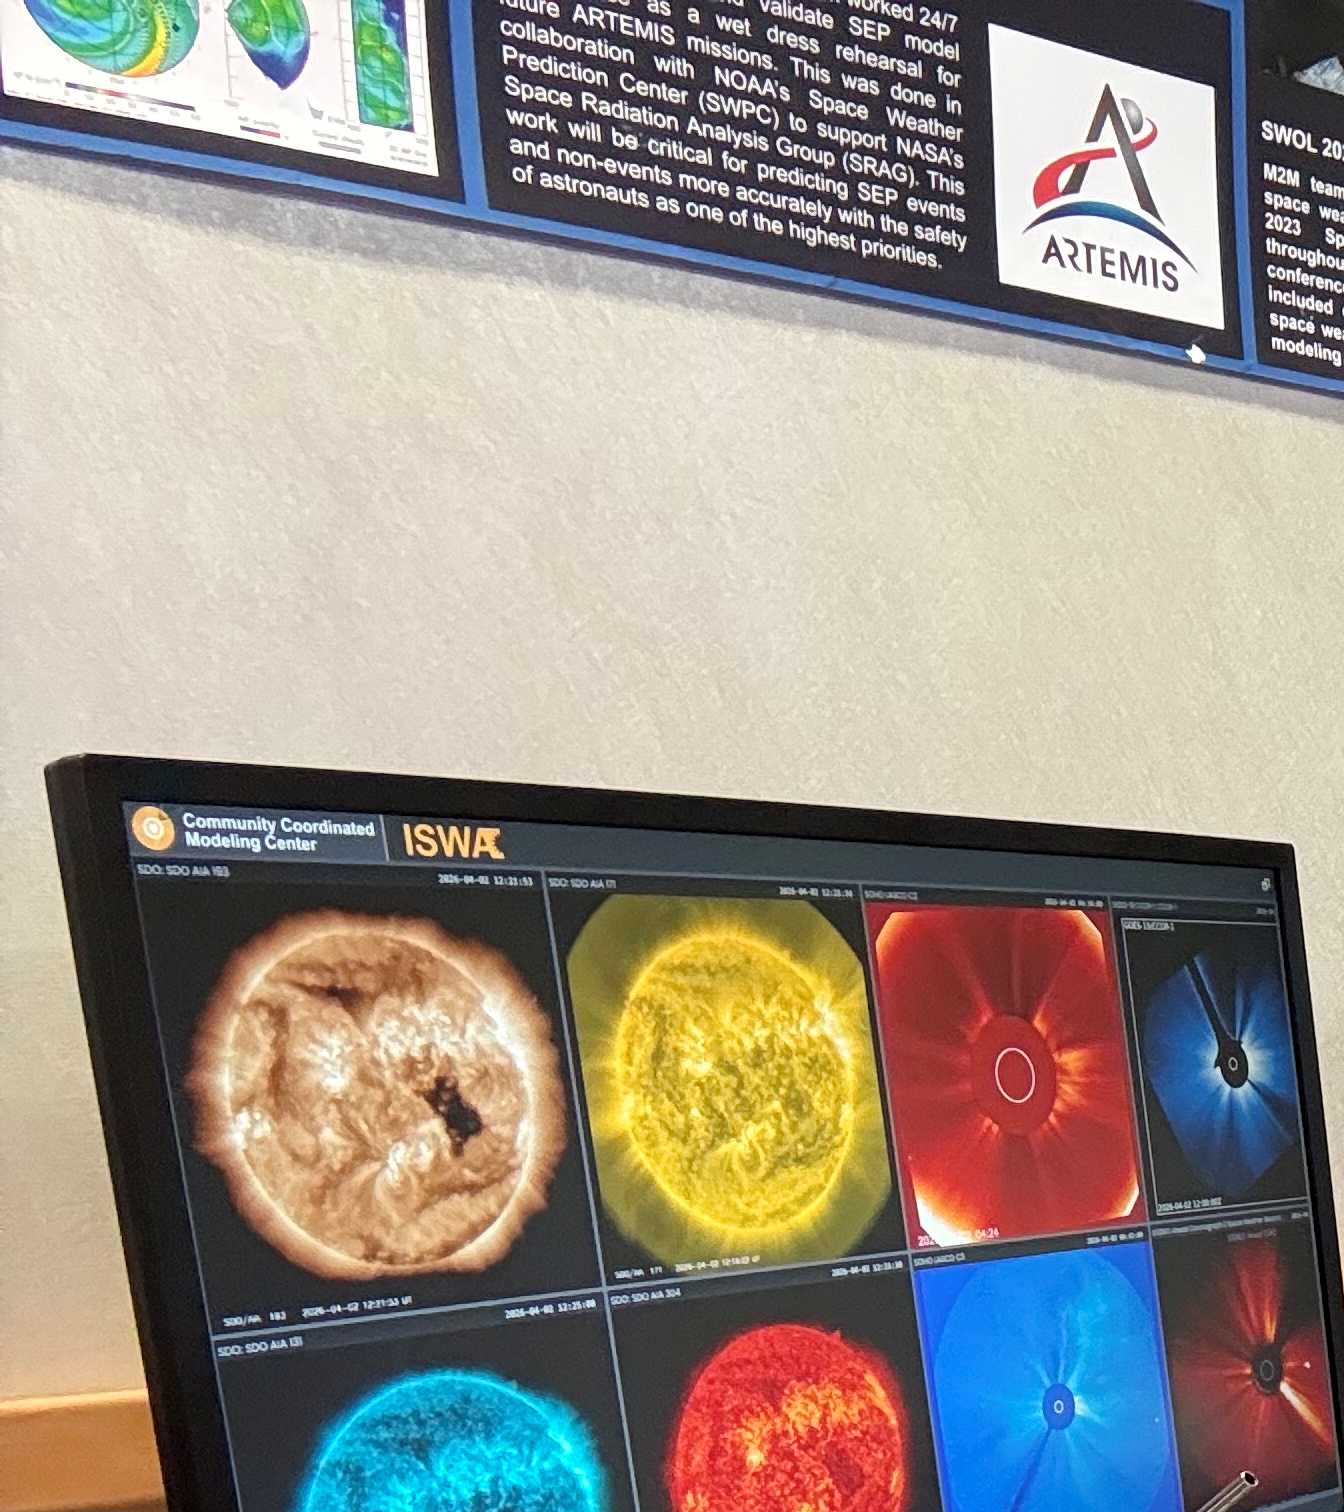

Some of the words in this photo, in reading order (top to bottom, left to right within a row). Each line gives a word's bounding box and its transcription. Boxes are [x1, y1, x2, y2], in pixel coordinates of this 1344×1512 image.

[499, 0, 560, 18] uture
[571, 3, 675, 46] ARTEMIS
[686, 34, 778, 71] missions.
[788, 55, 831, 84] This
[840, 72, 880, 96] was
[889, 81, 936, 109] done
[945, 93, 961, 115] in
[499, 19, 635, 65] collaboration
[653, 54, 694, 79] with
[713, 65, 790, 102] NOAA's
[808, 88, 869, 120] Space
[885, 105, 963, 142] Weather
[646, 0, 671, 16] as
[687, 7, 700, 24] a
[715, 13, 752, 37] wet
[766, 24, 820, 54] dress
[835, 43, 922, 78] rehearsal
[936, 64, 961, 88] for
[501, 43, 608, 88] Prediction
[618, 71, 688, 105] Center
[698, 89, 779, 131] (SWPC)
[788, 111, 807, 133] to
[816, 121, 888, 152] support
[896, 135, 964, 169] NASA's
[503, 74, 573, 108] Space
[580, 90, 679, 132] Radiation
[685, 115, 769, 152] Analysis
[775, 135, 835, 169] Group
[842, 150, 919, 188] (SRAG).
[925, 169, 965, 196] This
[1260, 119, 1318, 153] SWOL
[505, 107, 558, 133] work
[566, 119, 601, 142] will
[610, 125, 642, 150] be
[646, 137, 712, 166] critical
[721, 149, 748, 174] for
[756, 162, 848, 201] predicting
[857, 181, 898, 206] SEP
[905, 196, 966, 222] events
[509, 137, 550, 160] and
[556, 147, 672, 185] non-events
[678, 173, 730, 197] more
[735, 185, 832, 223] accurately
[837, 206, 875, 229] with
[879, 213, 908, 236] the
[913, 224, 967, 252] safety
[1263, 162, 1300, 187] M2M
[1263, 190, 1310, 214] space
[511, 164, 534, 184] of
[539, 171, 650, 208] astronauts
[655, 195, 680, 214] as
[685, 201, 723, 223] one
[728, 208, 748, 228] of
[752, 211, 783, 235] the
[788, 218, 856, 252] highest
[860, 237, 942, 268] priorities.
[1041, 233, 1180, 292] ARTEMIS
[182, 812, 277, 836] Community
[280, 816, 376, 837] Coordinated
[185, 831, 261, 853] Modeling
[265, 835, 318, 852] Center
[245, 1341, 268, 1354] SDO
